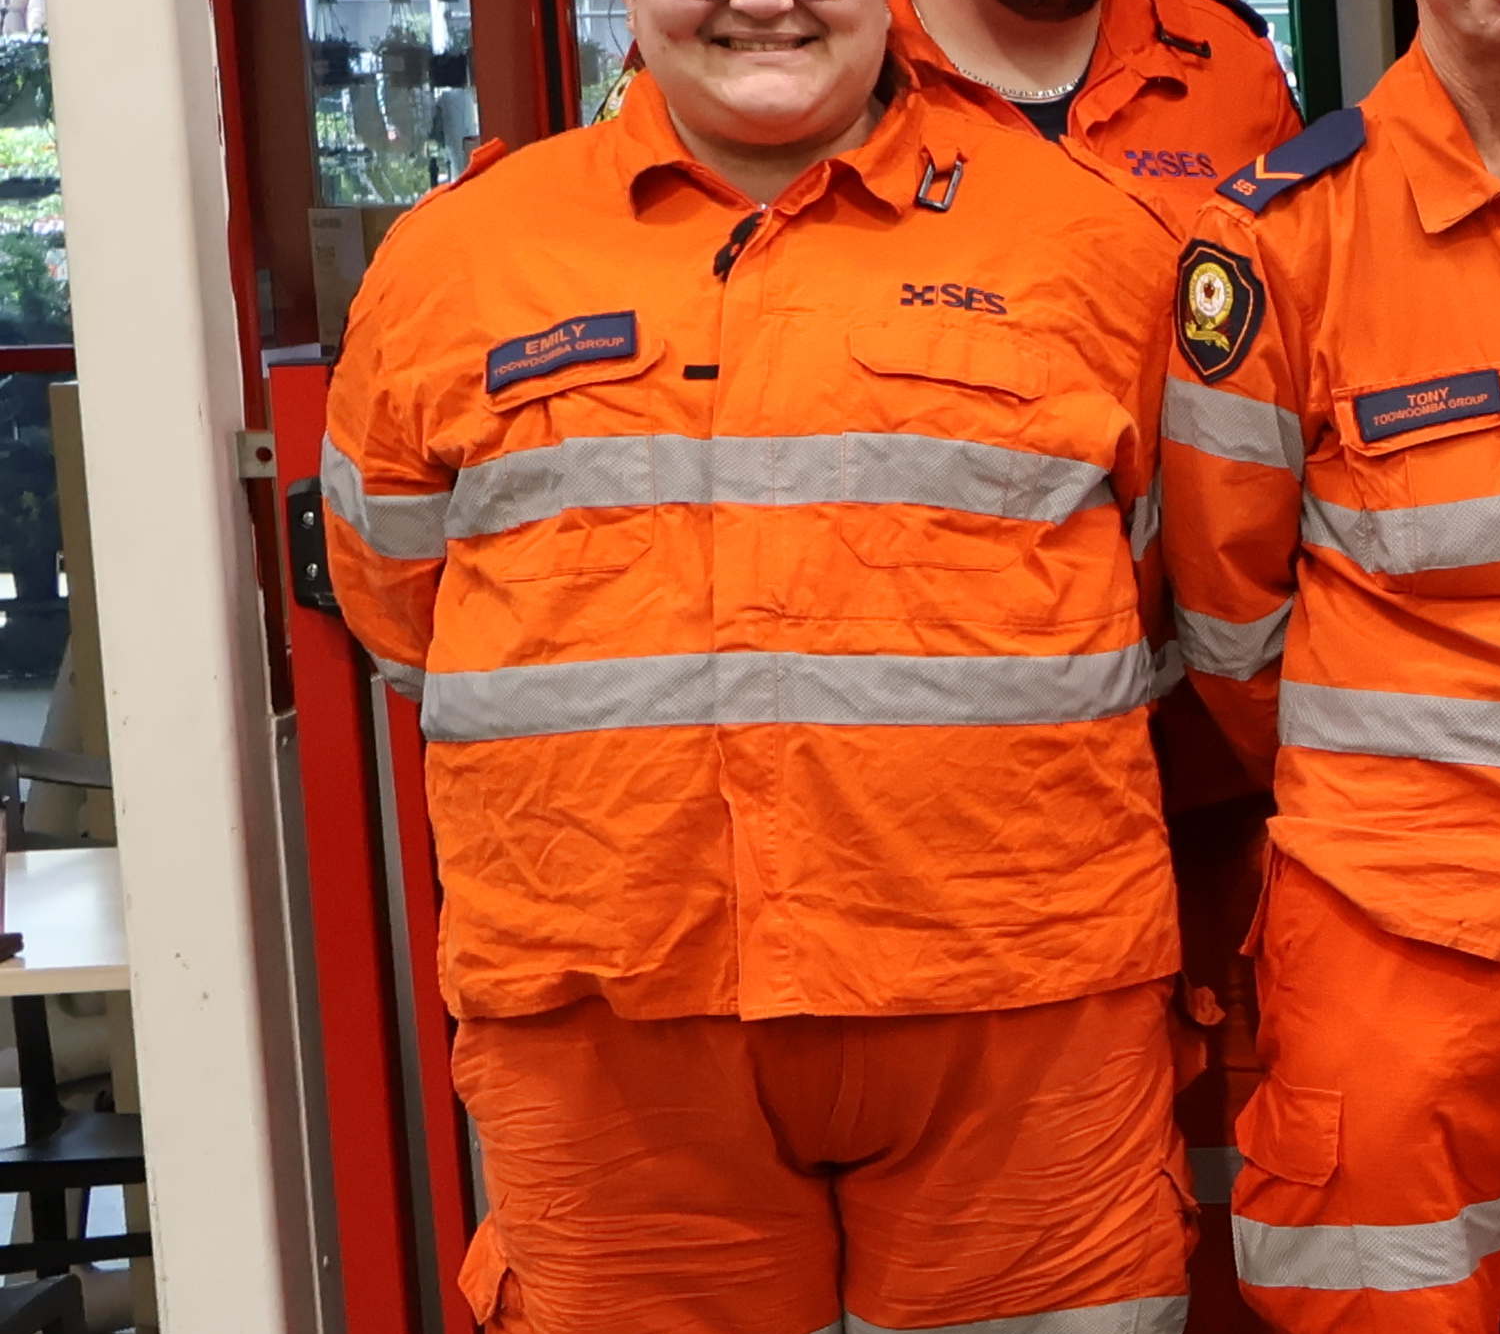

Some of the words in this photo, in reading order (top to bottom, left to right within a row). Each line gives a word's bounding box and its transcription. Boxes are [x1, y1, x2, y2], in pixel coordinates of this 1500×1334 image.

[1158, 151, 1217, 179] SES
[939, 283, 1008, 316] SES
[525, 323, 586, 355] EMILY
[574, 336, 625, 351] GROUP
[1407, 386, 1450, 407] TONY
[1448, 393, 1489, 410] GROUP
